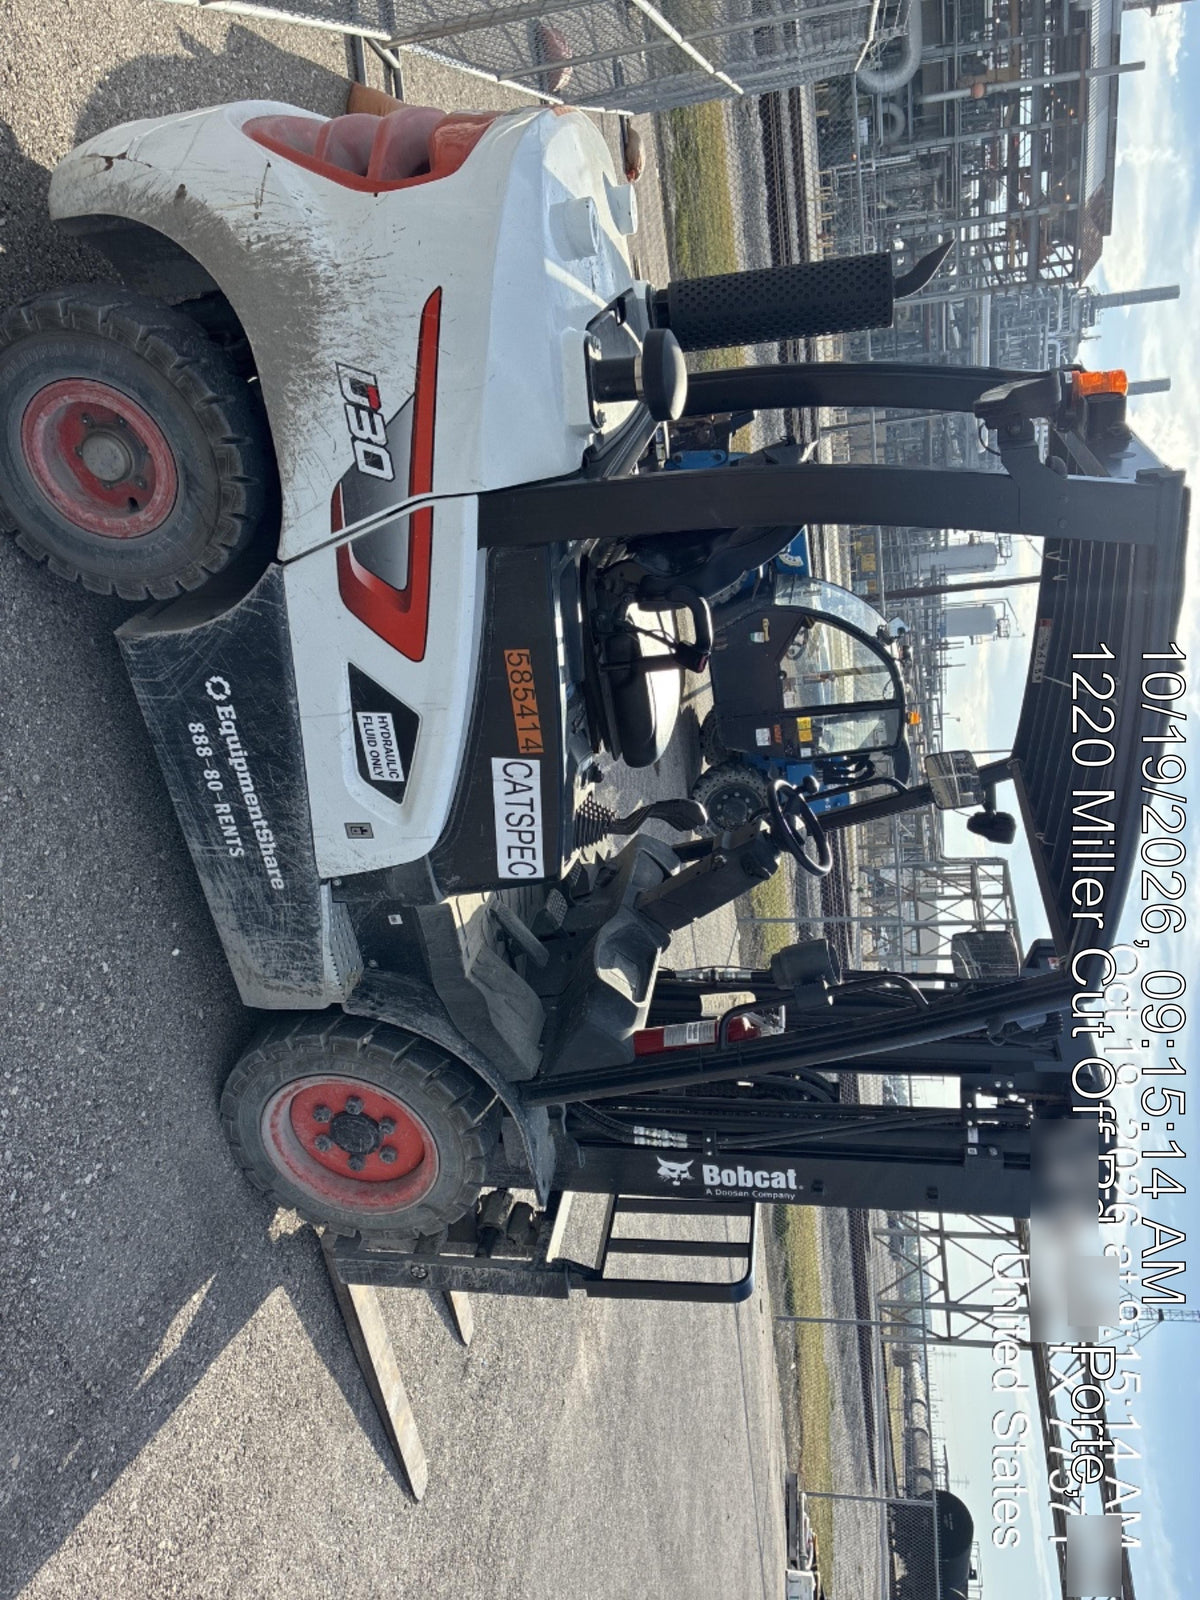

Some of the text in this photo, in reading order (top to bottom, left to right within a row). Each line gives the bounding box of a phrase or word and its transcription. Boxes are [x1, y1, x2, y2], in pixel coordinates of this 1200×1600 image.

[335, 361, 396, 482] D30
[361, 715, 384, 778] FLUID ONLY
[377, 715, 399, 779] HYDRAULIC
[506, 652, 543, 752] 585414
[188, 722, 245, 857] 888-80-RENTS
[216, 704, 285, 890] EquipmentShare
[502, 761, 538, 876] CATSPEC
[702, 1164, 797, 1190] Bobcat
[715, 1189, 749, 1197] Doosan
[751, 1190, 795, 1200] Company
